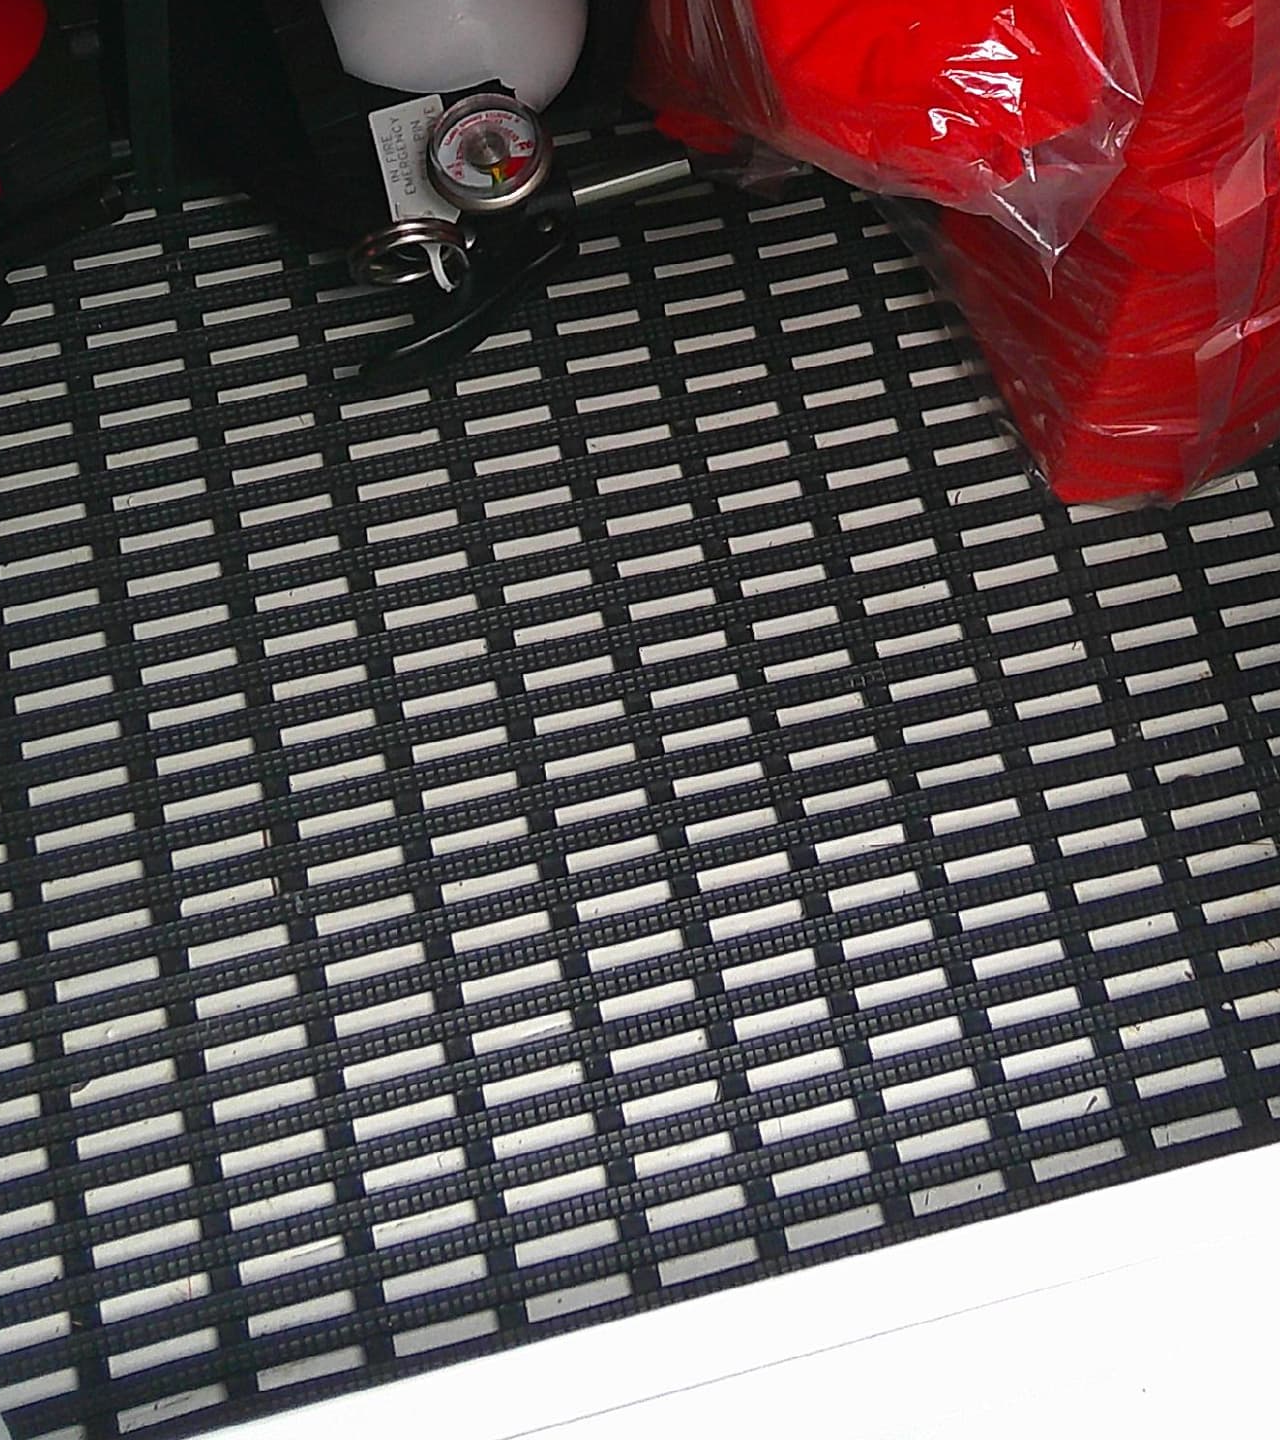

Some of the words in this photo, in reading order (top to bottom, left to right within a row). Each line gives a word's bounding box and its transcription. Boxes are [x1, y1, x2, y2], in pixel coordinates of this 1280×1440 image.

[380, 134, 398, 164] FIRE
[390, 116, 417, 196] EMERGENCY
[389, 169, 401, 183] IN
